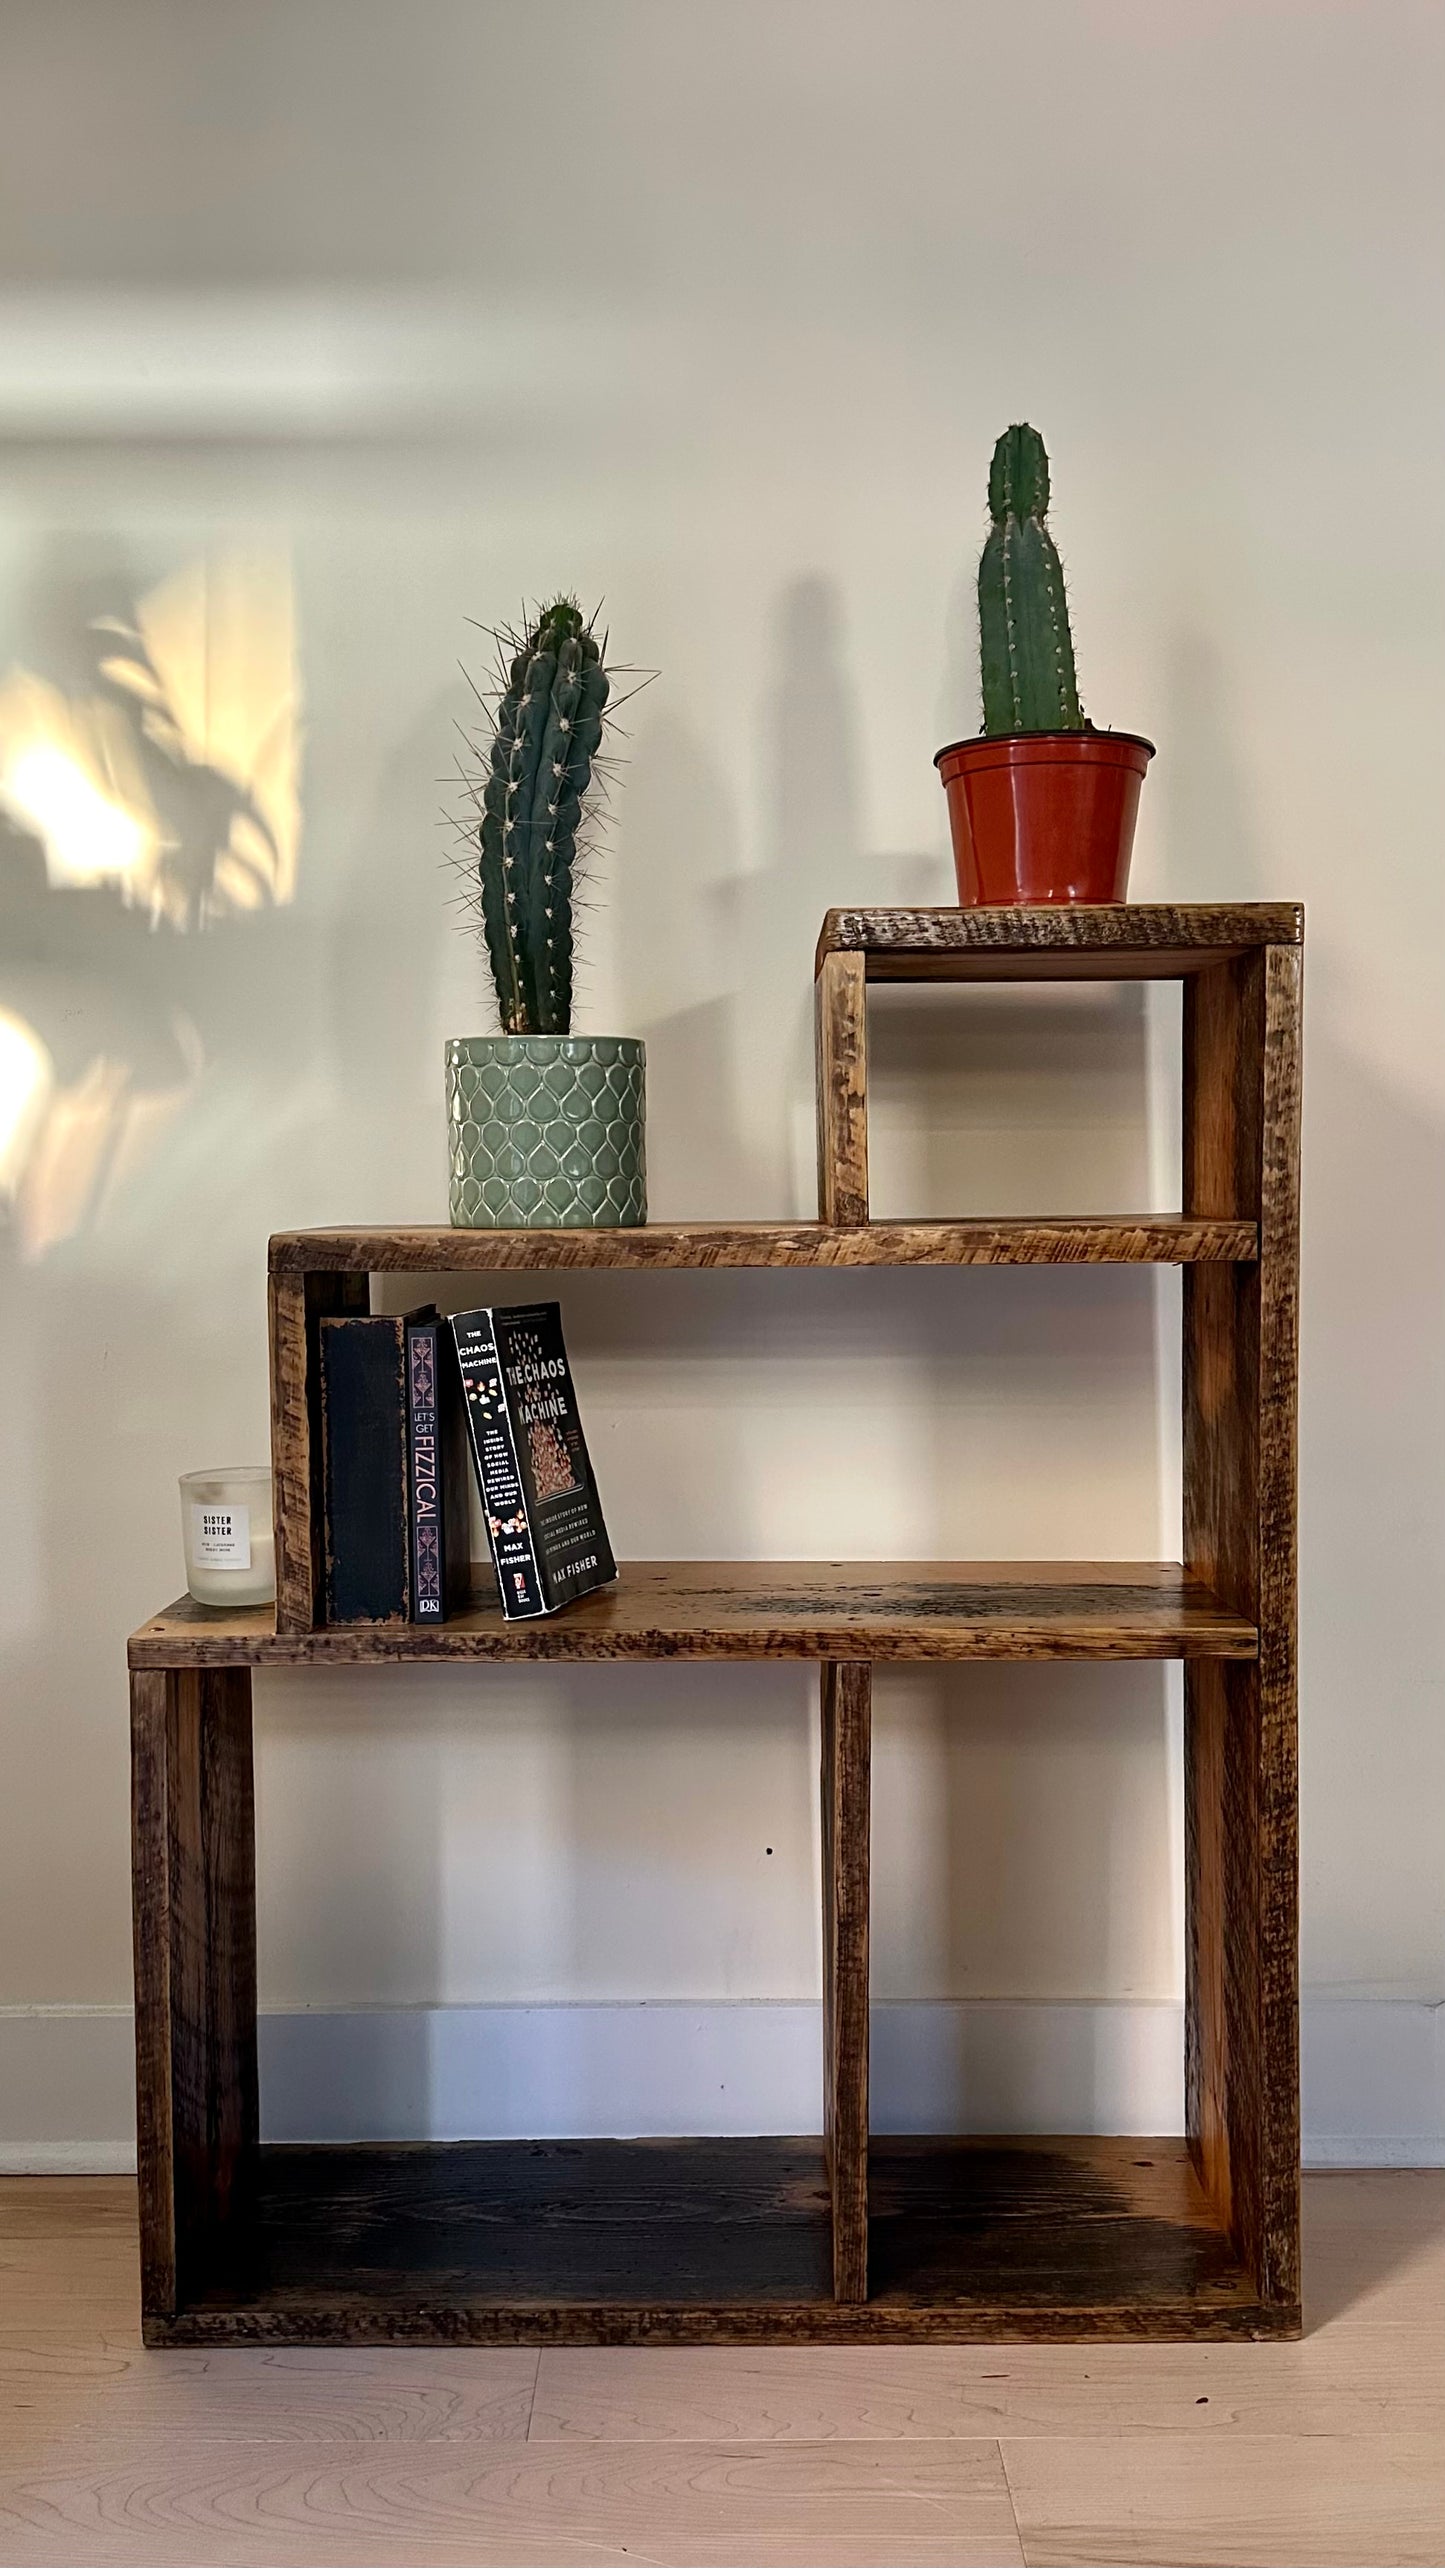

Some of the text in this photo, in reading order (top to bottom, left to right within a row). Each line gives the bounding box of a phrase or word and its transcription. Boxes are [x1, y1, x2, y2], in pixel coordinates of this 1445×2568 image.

[466, 1330, 482, 1339] THE
[459, 1342, 495, 1356] CHAOS
[461, 1357, 497, 1369] MACHINE
[506, 1358, 566, 1386] THE CHAOS
[518, 1397, 568, 1424] MACHINE
[414, 1412, 435, 1422] LET'S
[415, 1424, 434, 1433] GET
[485, 1444, 505, 1453] STORY
[493, 1451, 509, 1459] HOW
[486, 1460, 509, 1469] SOCIAL
[489, 1467, 509, 1476] MEDIA
[414, 1436, 437, 1523] FIZZICAL
[487, 1474, 515, 1484] REWIRED
[500, 1482, 519, 1490] MINDS
[494, 1498, 516, 1507] WORLD
[203, 1516, 231, 1525] SISTER
[204, 1527, 232, 1535] SISTER
[503, 1542, 524, 1552] MAX
[500, 1554, 531, 1566] FISHER
[566, 1555, 598, 1577] FISHER
